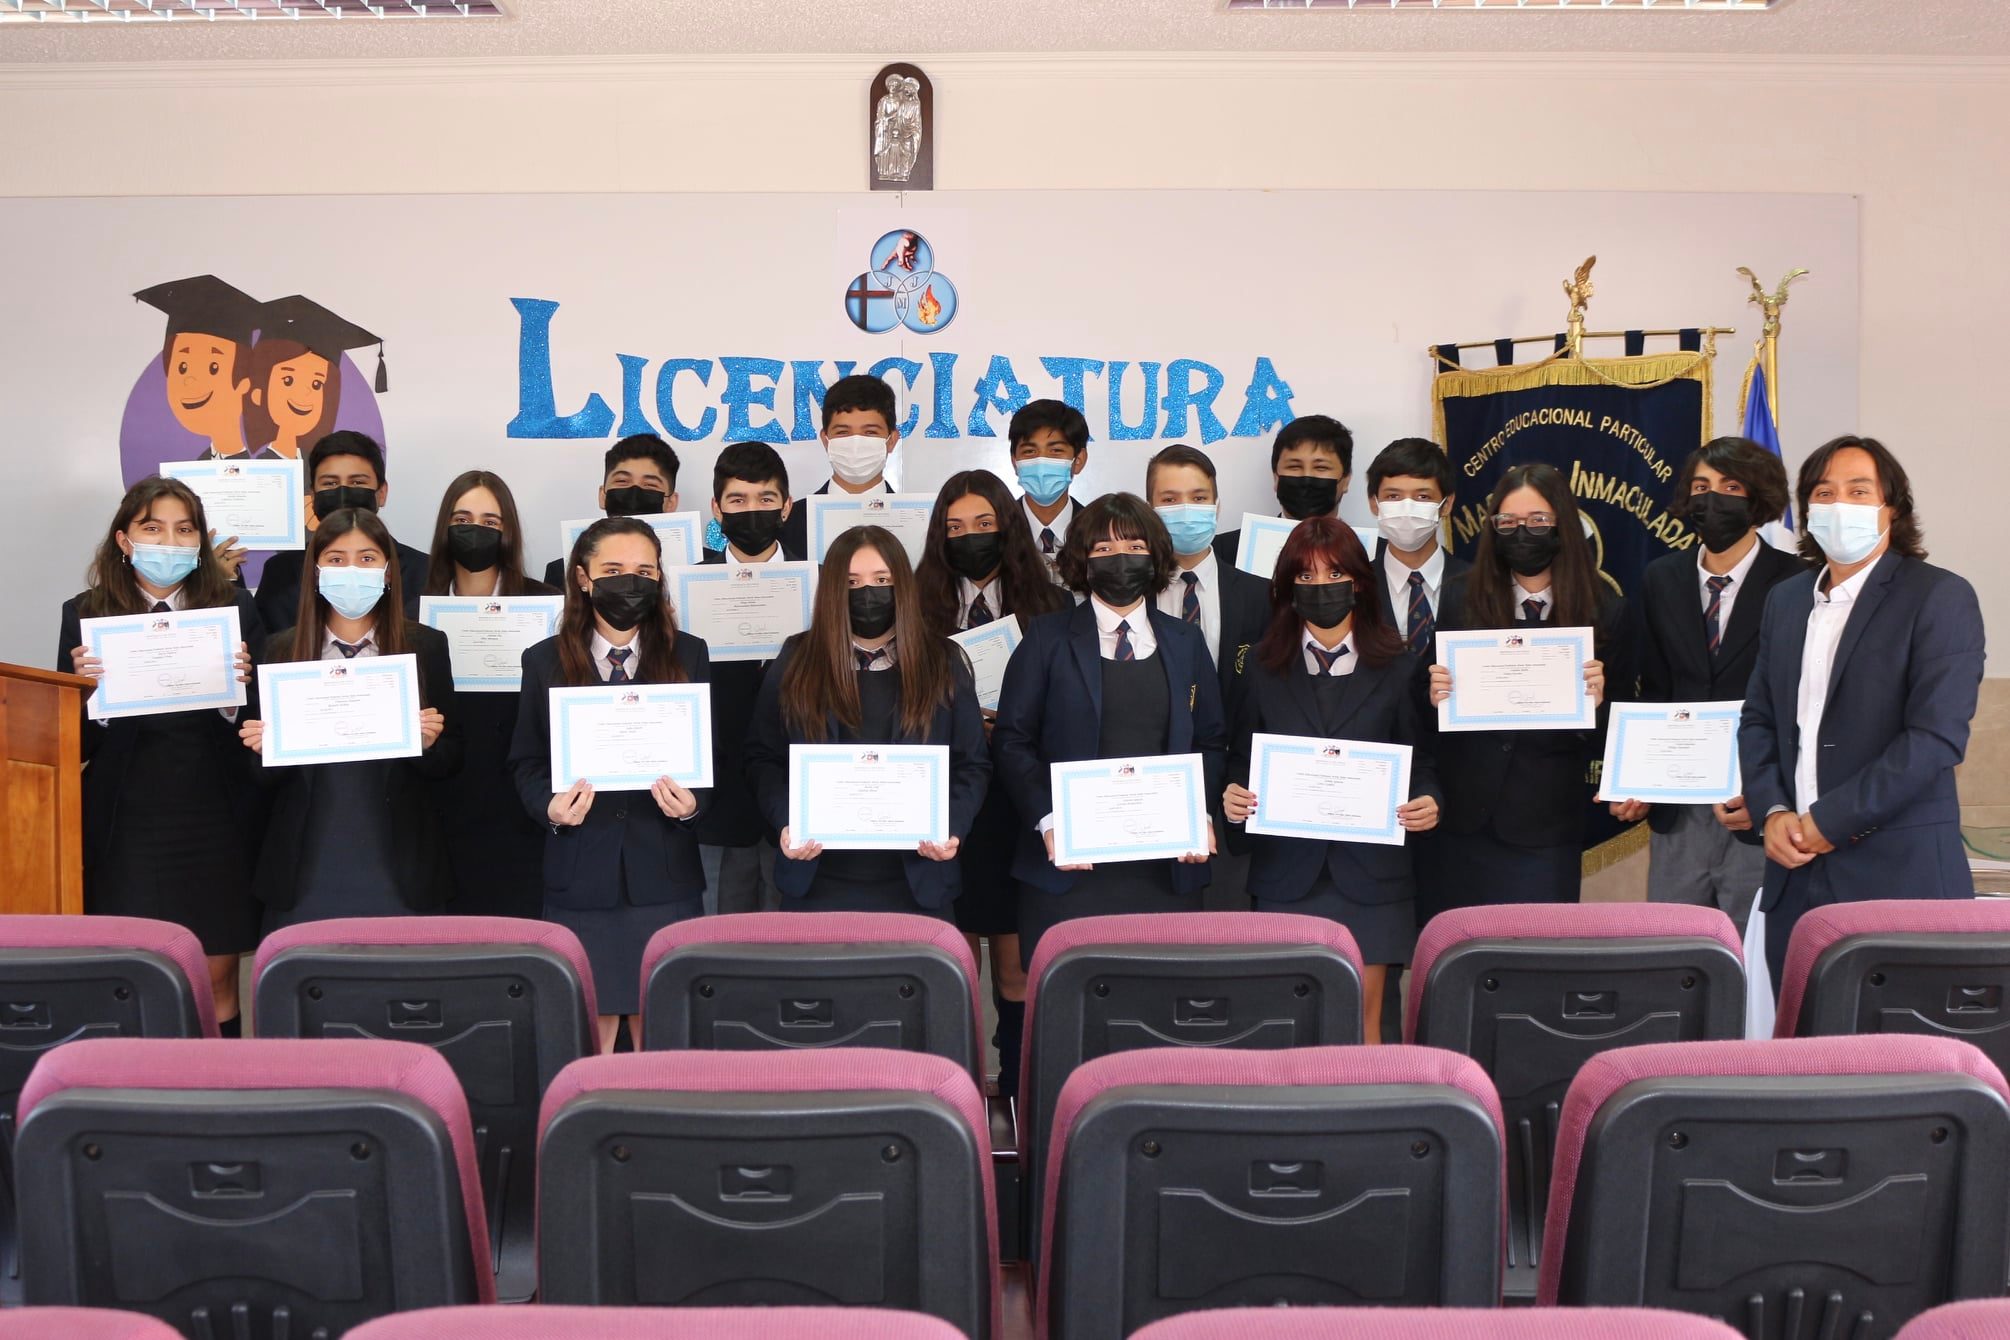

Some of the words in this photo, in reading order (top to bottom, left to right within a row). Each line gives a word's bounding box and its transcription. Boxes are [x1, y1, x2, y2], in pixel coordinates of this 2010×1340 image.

[506, 296, 1295, 445] LICENCIATURA
[1463, 430, 1504, 477] CENTRO
[1504, 407, 1594, 438] EDUCACIONAL
[1599, 415, 1673, 483] PARTICULAR
[1569, 460, 1696, 550] INMACULADA
